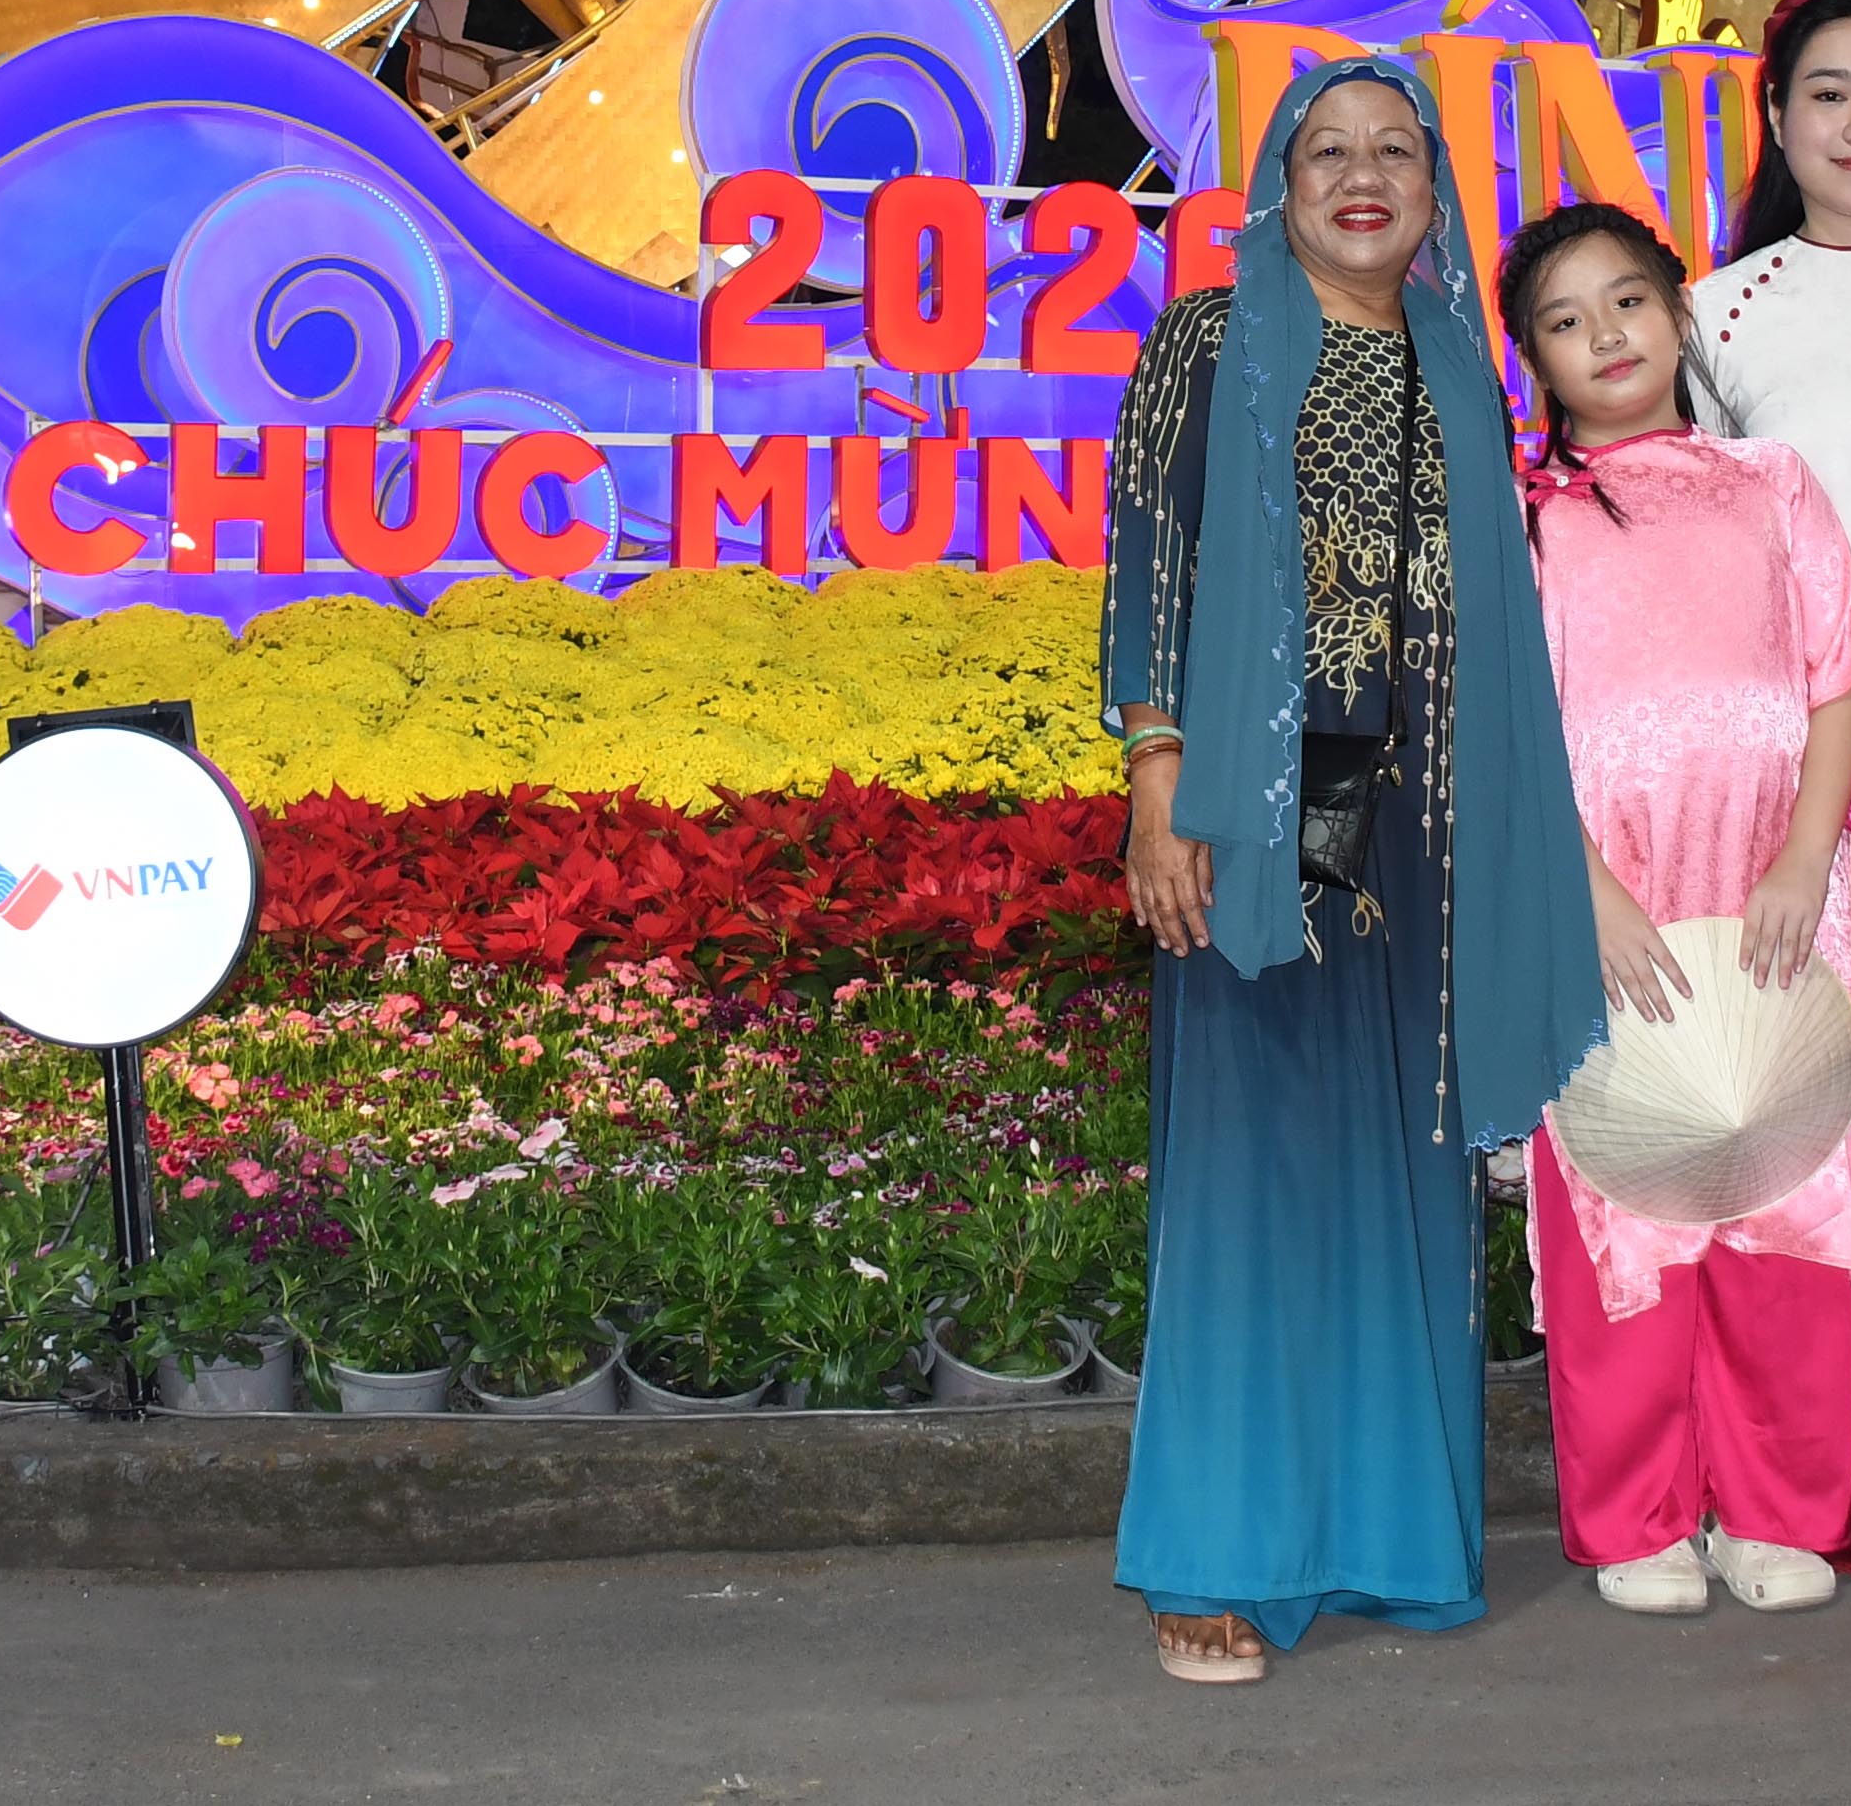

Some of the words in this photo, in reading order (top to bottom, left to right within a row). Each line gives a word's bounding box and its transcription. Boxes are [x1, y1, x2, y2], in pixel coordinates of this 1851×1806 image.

[4, 339, 616, 578] CHÚC
[671, 386, 1109, 576] MỪN
[72, 857, 214, 901] VNPAY
